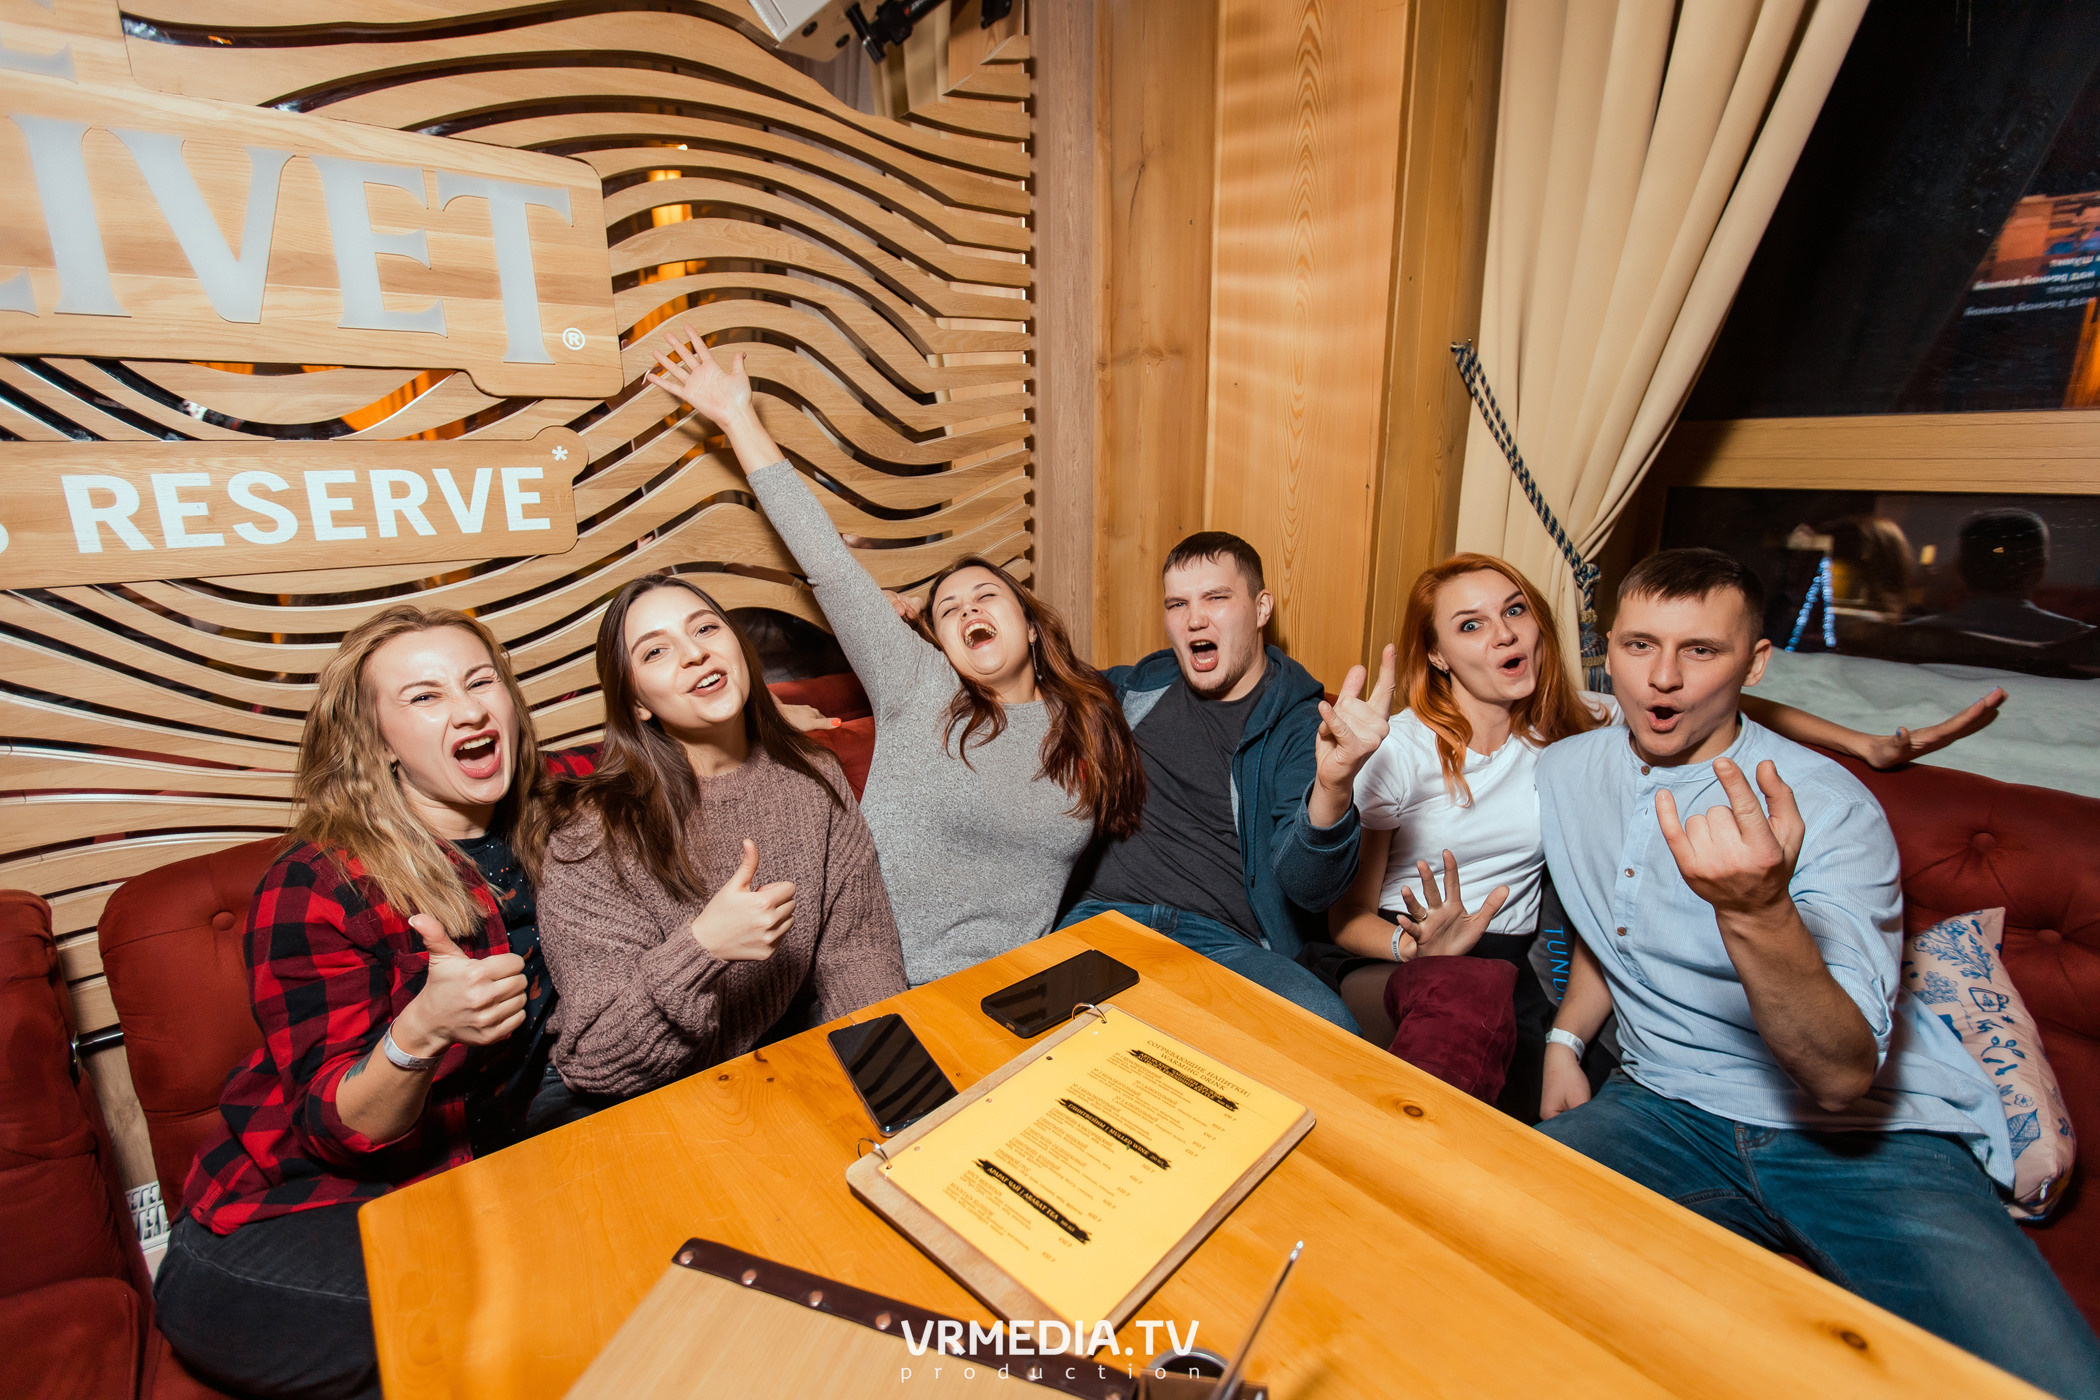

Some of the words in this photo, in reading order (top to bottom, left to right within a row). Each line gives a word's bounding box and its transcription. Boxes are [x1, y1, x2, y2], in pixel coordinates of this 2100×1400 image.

[0, 113, 574, 364] IVET
[61, 466, 551, 554] RESERVE
[1544, 926, 1571, 1000] TUND
[1146, 1040, 1206, 1072] СОГРЕВАЮЩИЕ
[1159, 1053, 1199, 1075] WARMING
[1199, 1074, 1226, 1090] DRINK
[1108, 1129, 1132, 1144] MULLED
[1131, 1143, 1148, 1154] WINE
[1006, 1180, 1022, 1191] ЧАЙ
[1045, 1209, 1058, 1219] TEA
